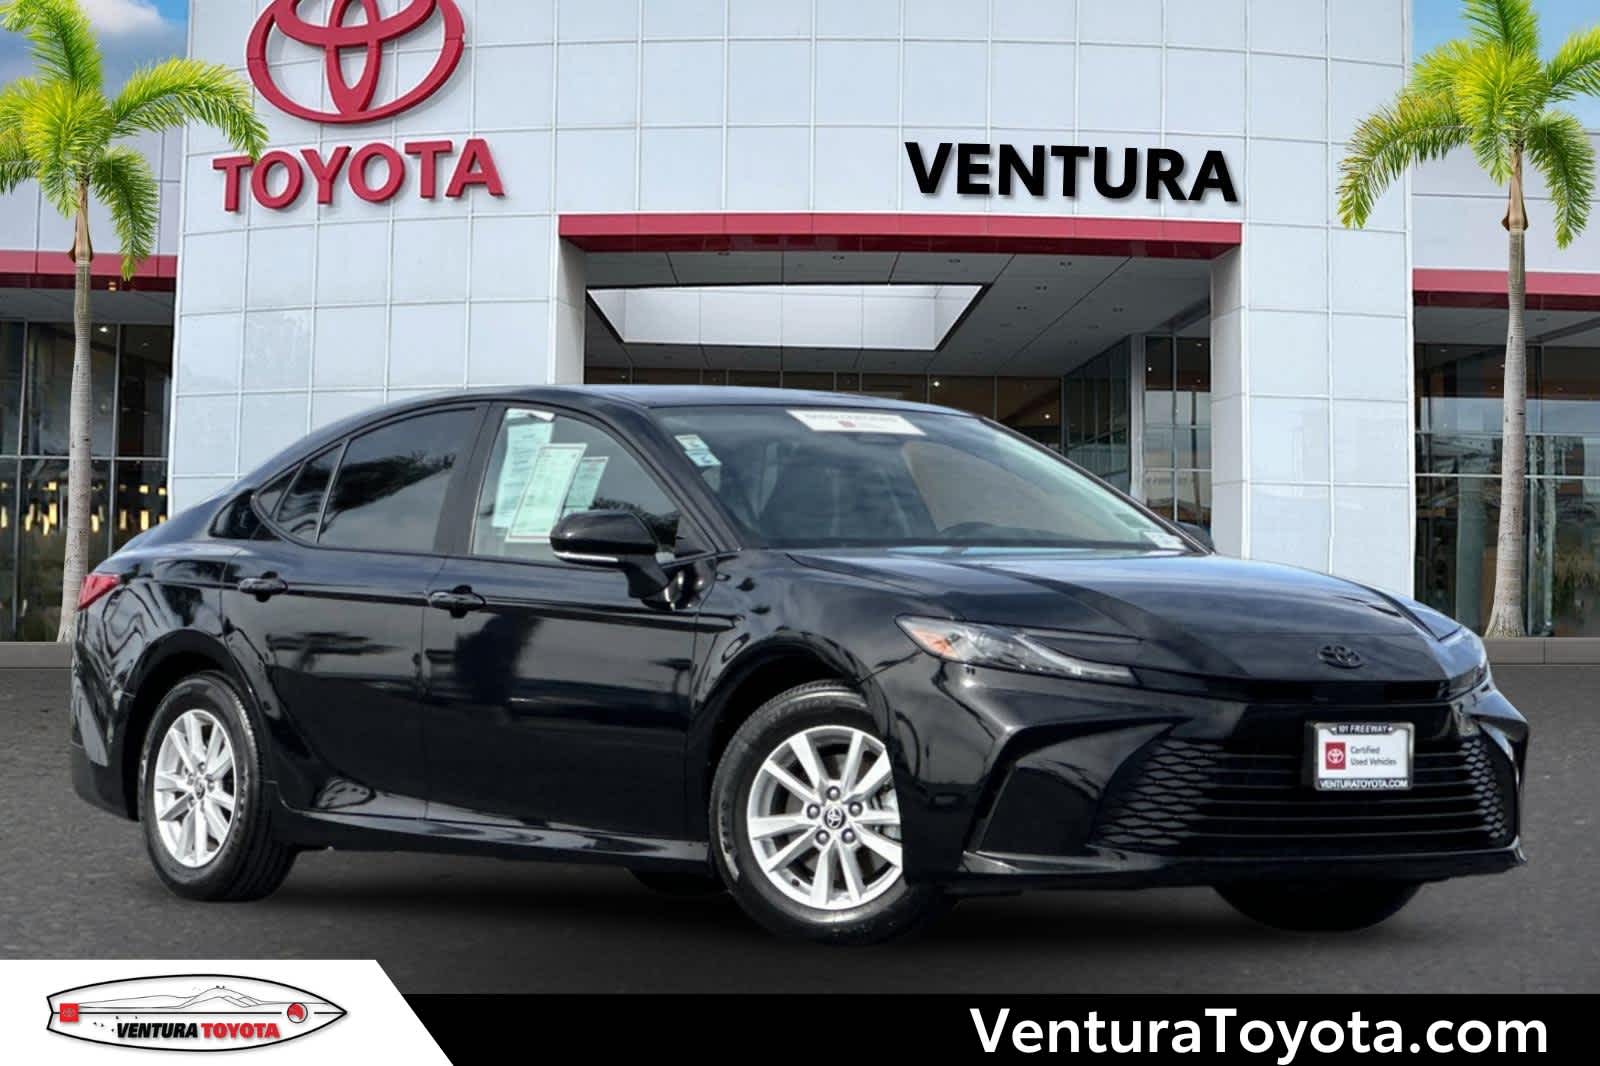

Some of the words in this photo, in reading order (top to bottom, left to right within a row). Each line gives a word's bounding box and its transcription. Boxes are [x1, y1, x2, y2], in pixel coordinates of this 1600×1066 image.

[213, 139, 505, 212] TOYOTA
[904, 141, 1238, 202] VENTURA
[1350, 724, 1388, 732] FREEWAY
[1350, 746, 1380, 754] Certified
[1350, 758, 1368, 766] Used
[1369, 758, 1397, 766] Vehicles
[1319, 780, 1409, 789] VENTURATOYOTA.COM
